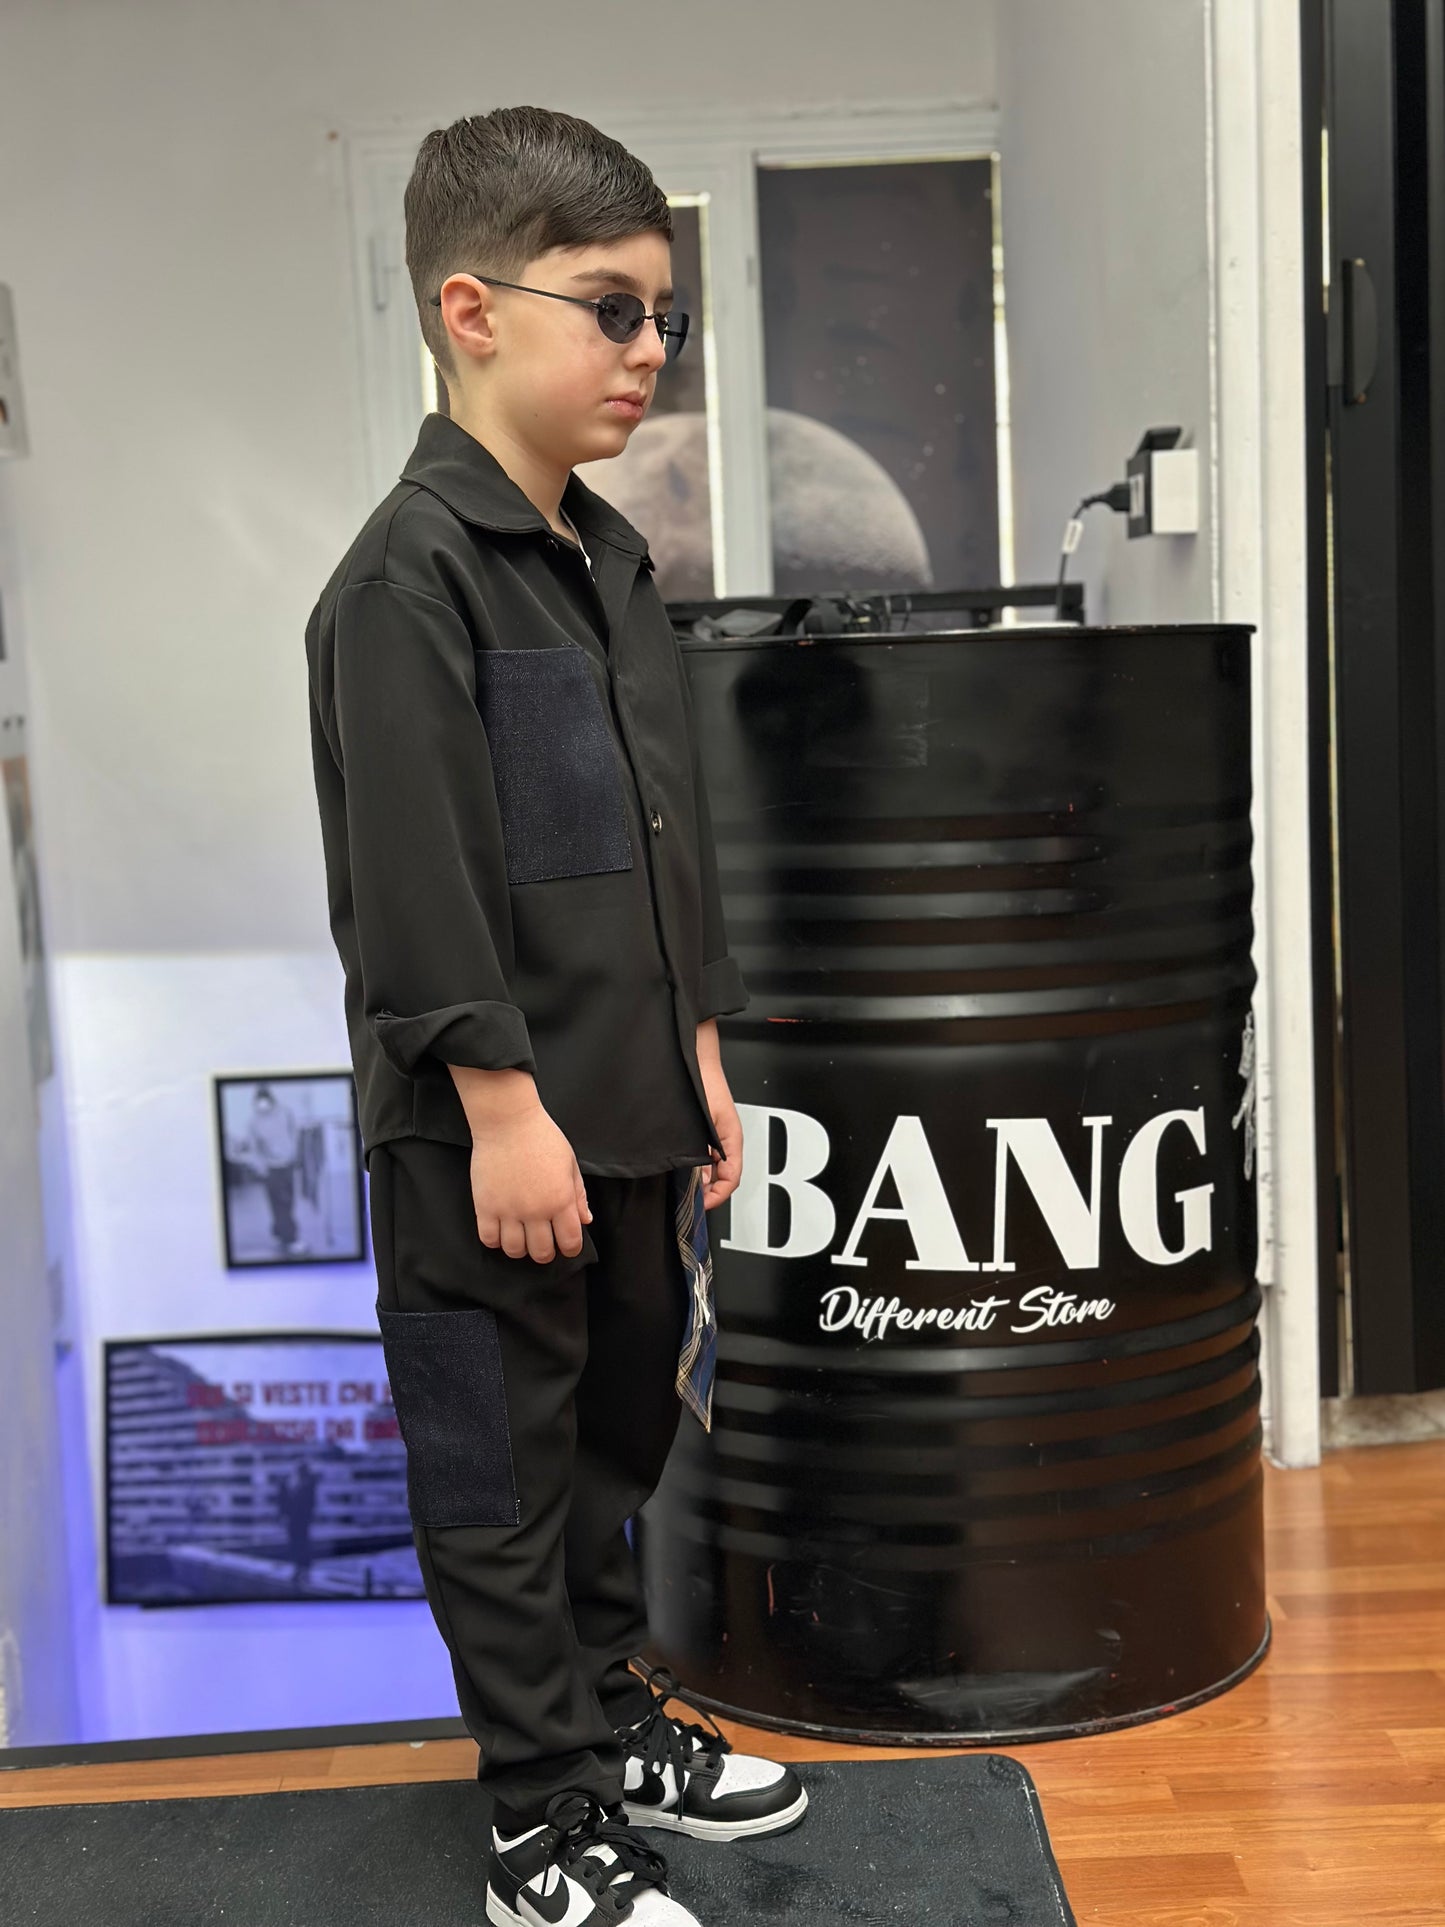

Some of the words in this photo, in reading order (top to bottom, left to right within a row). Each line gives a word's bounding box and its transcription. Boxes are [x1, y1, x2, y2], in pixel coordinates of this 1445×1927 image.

[720, 1103, 1215, 1272] BANG
[819, 1286, 1010, 1339] Different
[1011, 1286, 1116, 1333] Store
[262, 1383, 328, 1406] VESTE
